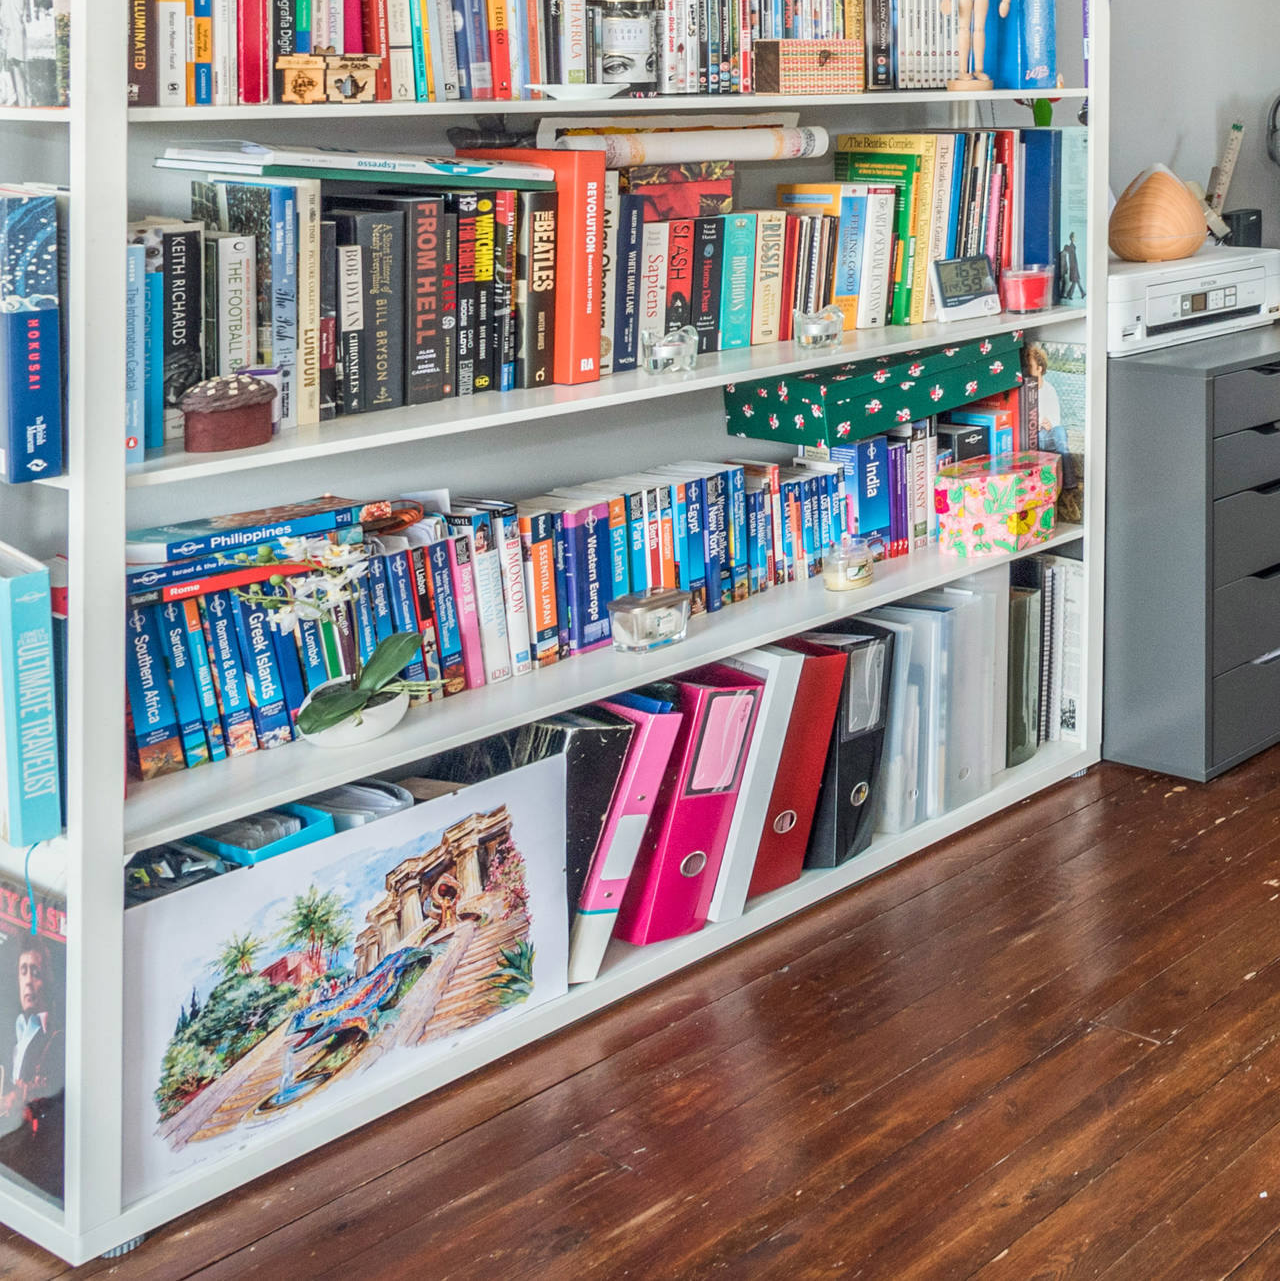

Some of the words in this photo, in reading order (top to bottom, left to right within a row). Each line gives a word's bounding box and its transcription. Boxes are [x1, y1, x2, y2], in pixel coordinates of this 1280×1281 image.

[330, 6, 341, 36] clever
[495, 6, 504, 45] TEDESCO
[879, 21, 887, 50] CROWN
[570, 15, 582, 60] AFRICA
[1032, 26, 1042, 59] Course
[848, 137, 862, 148] The
[864, 137, 887, 149] Beatles
[940, 146, 948, 160] The
[357, 158, 396, 170] Espresso
[534, 211, 554, 222] THE
[586, 182, 597, 253] REVOLUTION
[874, 211, 885, 228] ART
[370, 224, 383, 250] Nearly
[382, 232, 393, 253] Short
[416, 202, 437, 271] FROM
[458, 226, 476, 240] FOR
[474, 213, 493, 282] WATCHMEN
[848, 214, 859, 258] FEELING
[172, 236, 186, 274] KEITH
[308, 250, 316, 280] PICTURE
[345, 249, 361, 278] BOB
[458, 243, 476, 284] VENDETTA
[533, 221, 554, 292] BEATLES
[627, 251, 637, 273] WHITE
[670, 224, 690, 280] SLASH
[760, 224, 781, 282] RUSSIA
[228, 260, 242, 284] THE
[369, 251, 382, 295] Everything
[381, 254, 393, 285] History
[626, 276, 636, 294] HART
[702, 259, 712, 288] Homo
[846, 260, 858, 292] GOOD
[127, 286, 138, 304] The
[275, 288, 294, 309] The
[381, 286, 393, 294] of
[442, 263, 456, 312] MAUS
[643, 254, 664, 318] Sapiens
[701, 290, 712, 312] Deus
[172, 278, 186, 346] RICHARDS
[308, 282, 316, 324] COLLECTION
[345, 281, 361, 328] DYLAN
[376, 299, 388, 326] BILL
[416, 276, 436, 345] HELL
[626, 296, 636, 315] LANE
[126, 306, 138, 359] Information
[228, 288, 243, 353] FOOTBALL
[275, 316, 295, 342] Posh
[27, 318, 40, 390] HOKUSAI
[304, 328, 317, 388] LONDON
[348, 333, 359, 394] CHRONICLES
[376, 331, 388, 381] BRYSON
[580, 358, 594, 371] RA
[126, 361, 138, 392] Capital
[26, 426, 37, 454] Museum
[36, 424, 47, 446] British
[866, 461, 880, 498] India
[915, 443, 927, 510] GERMANY
[714, 494, 726, 530] Western
[784, 502, 792, 515] LAS
[803, 498, 812, 528] VENICE
[811, 496, 819, 510] SAN
[820, 494, 828, 508] LOS
[832, 492, 840, 516] SEOUL
[688, 503, 700, 534] Egypt
[708, 506, 718, 532] New
[757, 511, 766, 547] ISTANBUL
[812, 510, 820, 548] FRANCISCO
[820, 509, 829, 544] ANGELES
[210, 524, 292, 547] Philippines
[613, 529, 624, 546] Sri
[632, 522, 644, 550] Paris
[648, 523, 660, 550] Berlin
[662, 522, 672, 560] Amsterdam
[709, 534, 720, 557] York
[717, 531, 726, 564] Balkans
[172, 565, 194, 577] Israel
[204, 561, 217, 573] the
[538, 544, 550, 592] ESSENTIAL
[555, 540, 564, 571] Edinburgh
[586, 535, 599, 580] Western
[613, 549, 624, 583] Lanka
[170, 583, 200, 595] Rome
[414, 568, 427, 594] Lisbon
[435, 571, 444, 585] Laos
[441, 568, 451, 592] Vietnam,
[460, 566, 472, 592] Tokyo
[488, 554, 500, 601] ESTONIA,
[507, 550, 525, 614] MOSCOW
[374, 582, 388, 617] Bangkok
[436, 592, 447, 619] Northern
[444, 594, 455, 629] Cambodia,
[478, 566, 493, 625] LITHUANIA
[541, 594, 552, 625] JAPAN
[588, 582, 600, 621] Europe
[248, 612, 268, 652] Greek
[439, 619, 451, 649] Thailand
[493, 603, 504, 638] LATVIA
[170, 628, 185, 668] Sardinia
[216, 619, 233, 659] Romania
[225, 670, 242, 706] Bulgaria
[304, 630, 320, 668] Lombok
[17, 640, 53, 718] ULTIMATE
[134, 634, 154, 690] Southern
[146, 691, 161, 724] Africa
[256, 654, 276, 699] Islands
[21, 714, 56, 800] TRAVELIST
